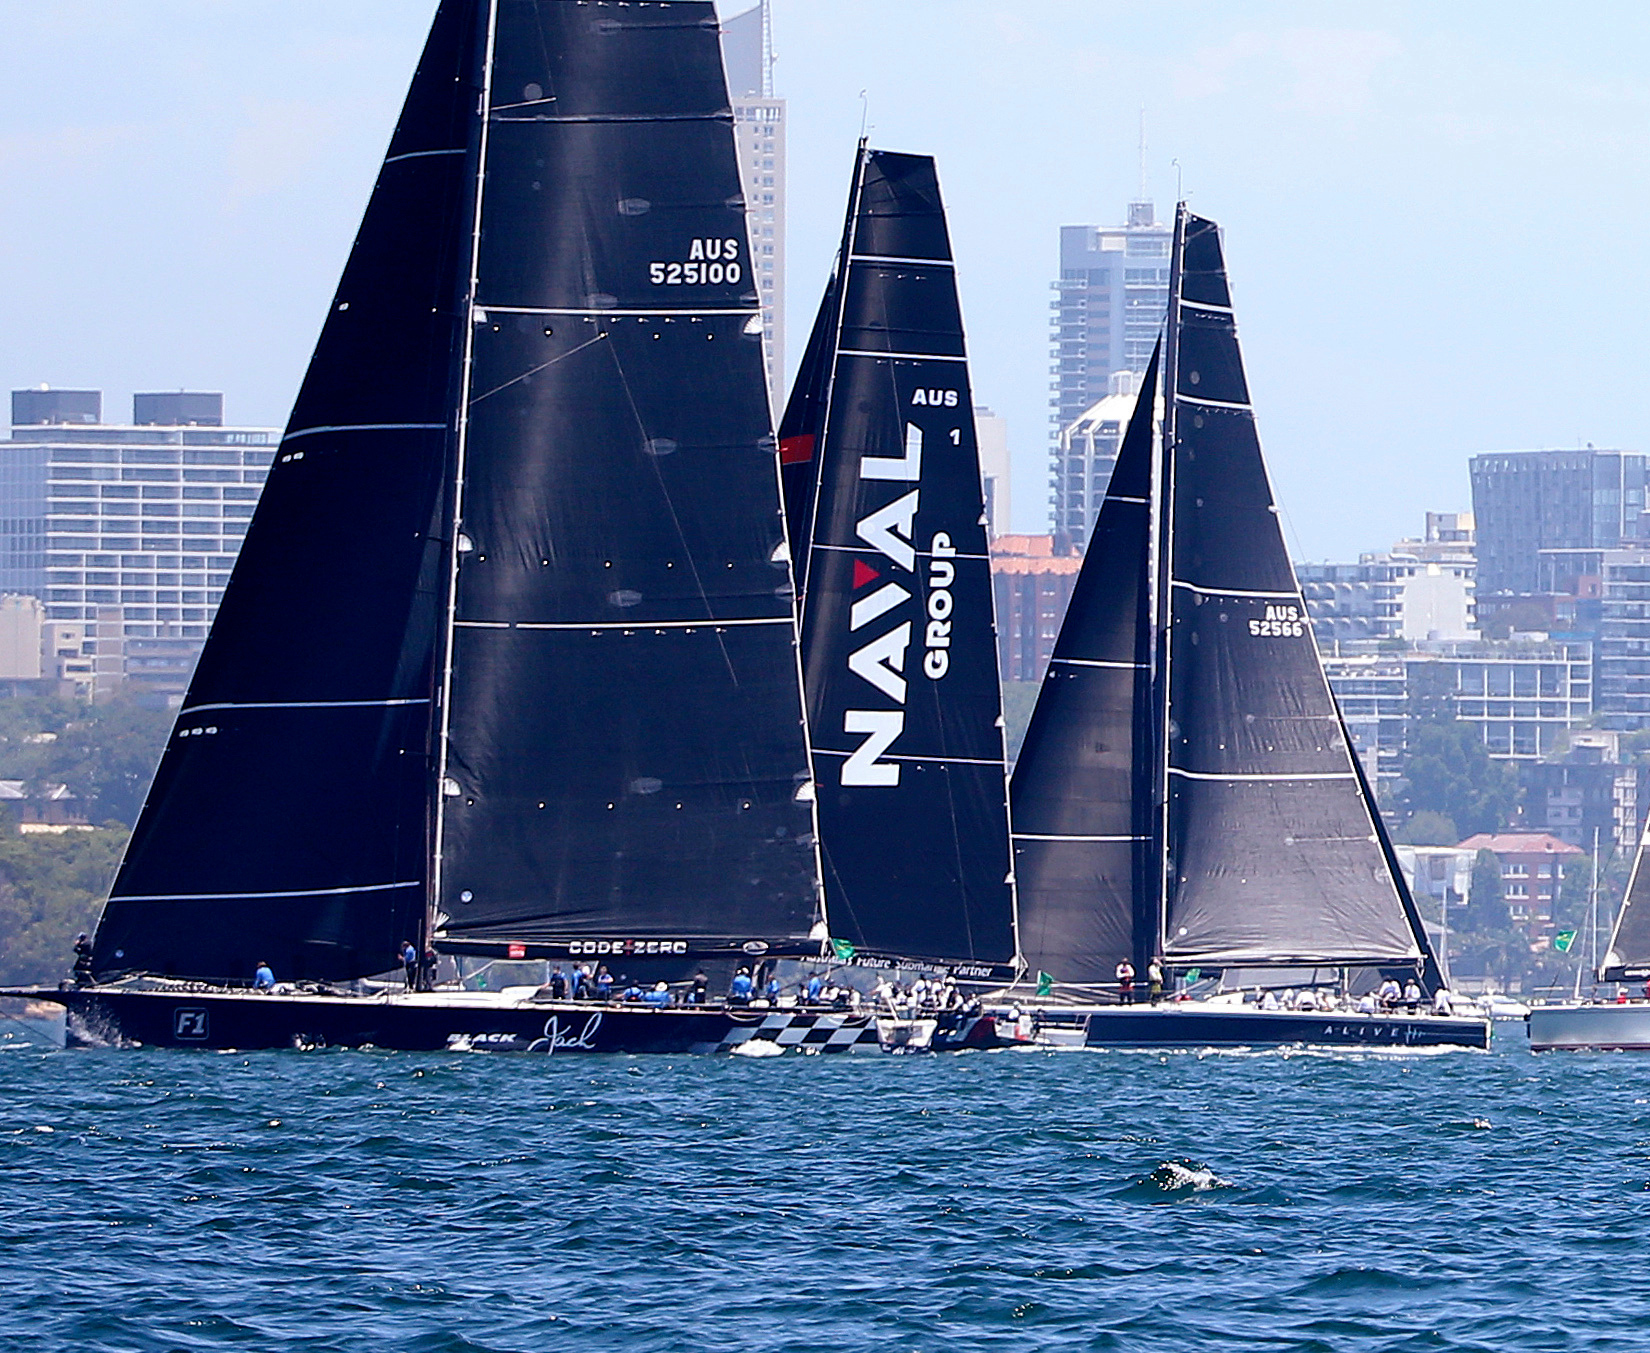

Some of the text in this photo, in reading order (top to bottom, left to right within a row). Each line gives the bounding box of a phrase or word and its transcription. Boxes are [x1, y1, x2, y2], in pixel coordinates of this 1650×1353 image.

[689, 238, 739, 260] AUS
[649, 262, 741, 284] 525100
[912, 388, 958, 407] AUS
[949, 428, 961, 445] 1
[840, 422, 923, 787] NAVAL
[924, 531, 957, 680] GROUP
[1266, 605, 1298, 621] AUS
[1249, 620, 1303, 637] 52566
[569, 941, 687, 954] CODE ZERO
[177, 1013, 205, 1034] F1
[1324, 1026, 1399, 1037] ALIVE
